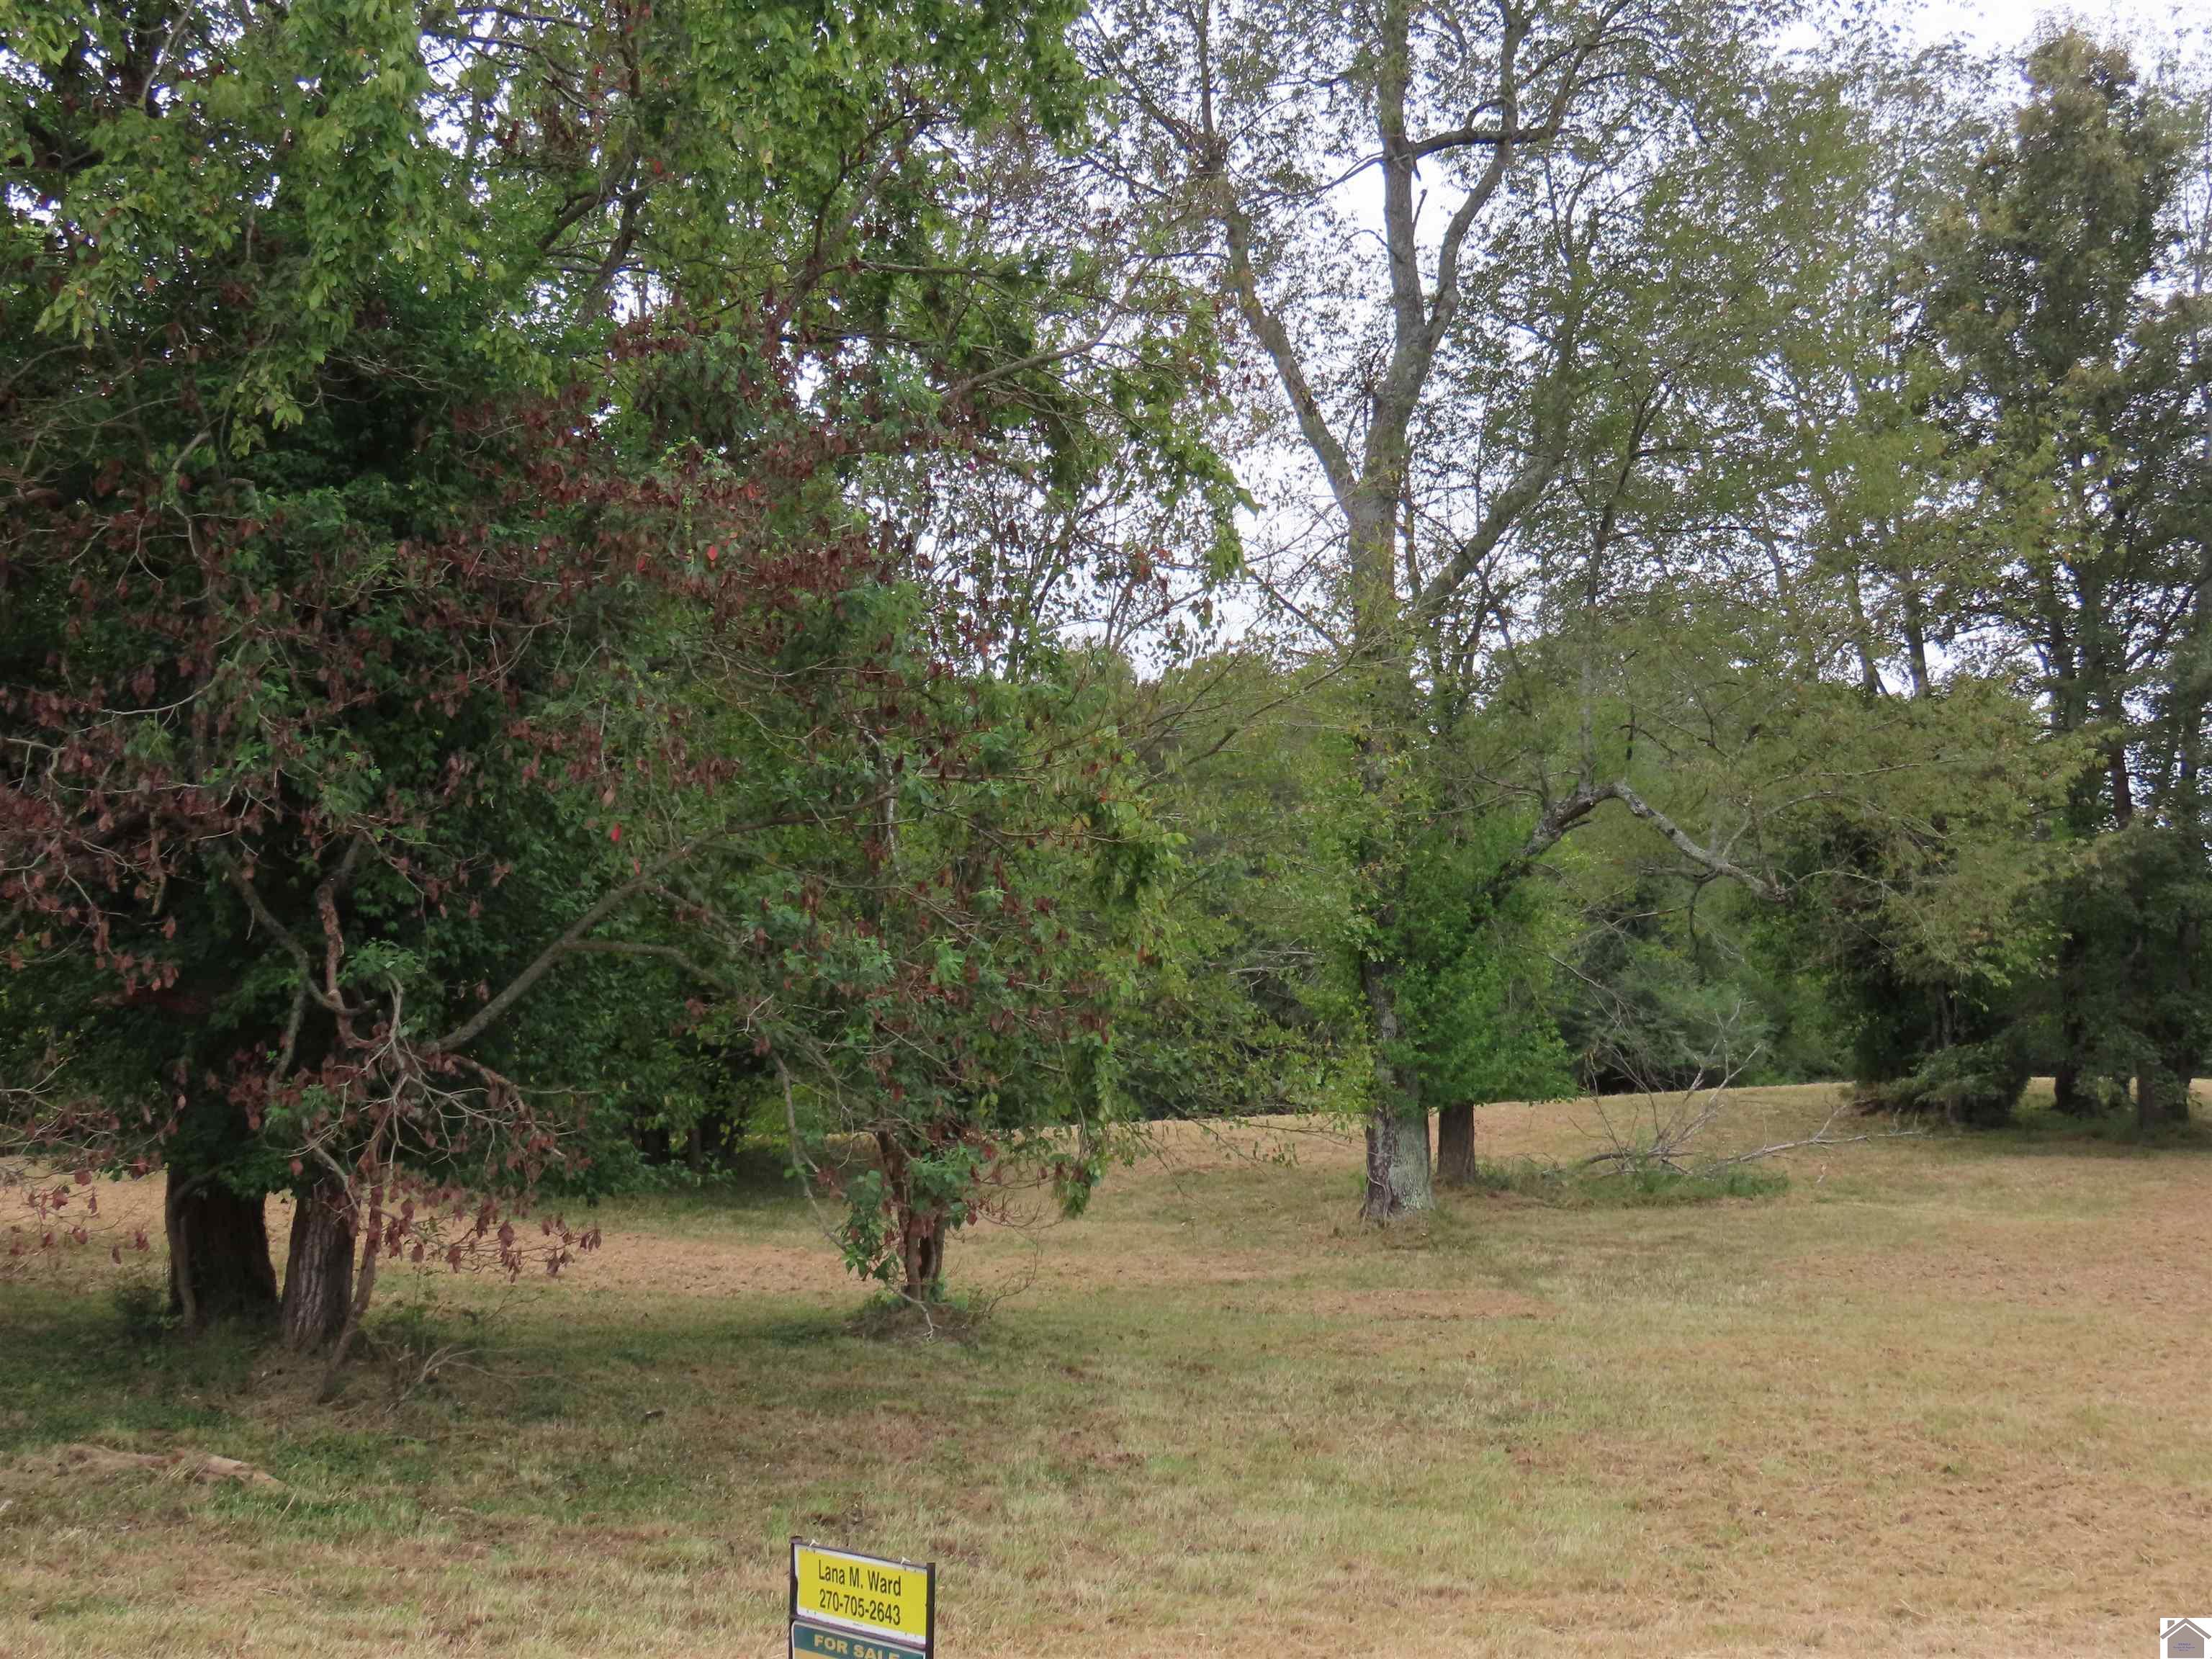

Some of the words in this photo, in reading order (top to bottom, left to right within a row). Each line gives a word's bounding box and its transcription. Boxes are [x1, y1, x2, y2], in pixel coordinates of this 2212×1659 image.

[818, 1560, 845, 1585] Lana
[849, 1566, 863, 1588] M.
[868, 1570, 902, 1596] Ward
[819, 1588, 901, 1625] 270-705-2643
[814, 1634, 848, 1654] FOR
